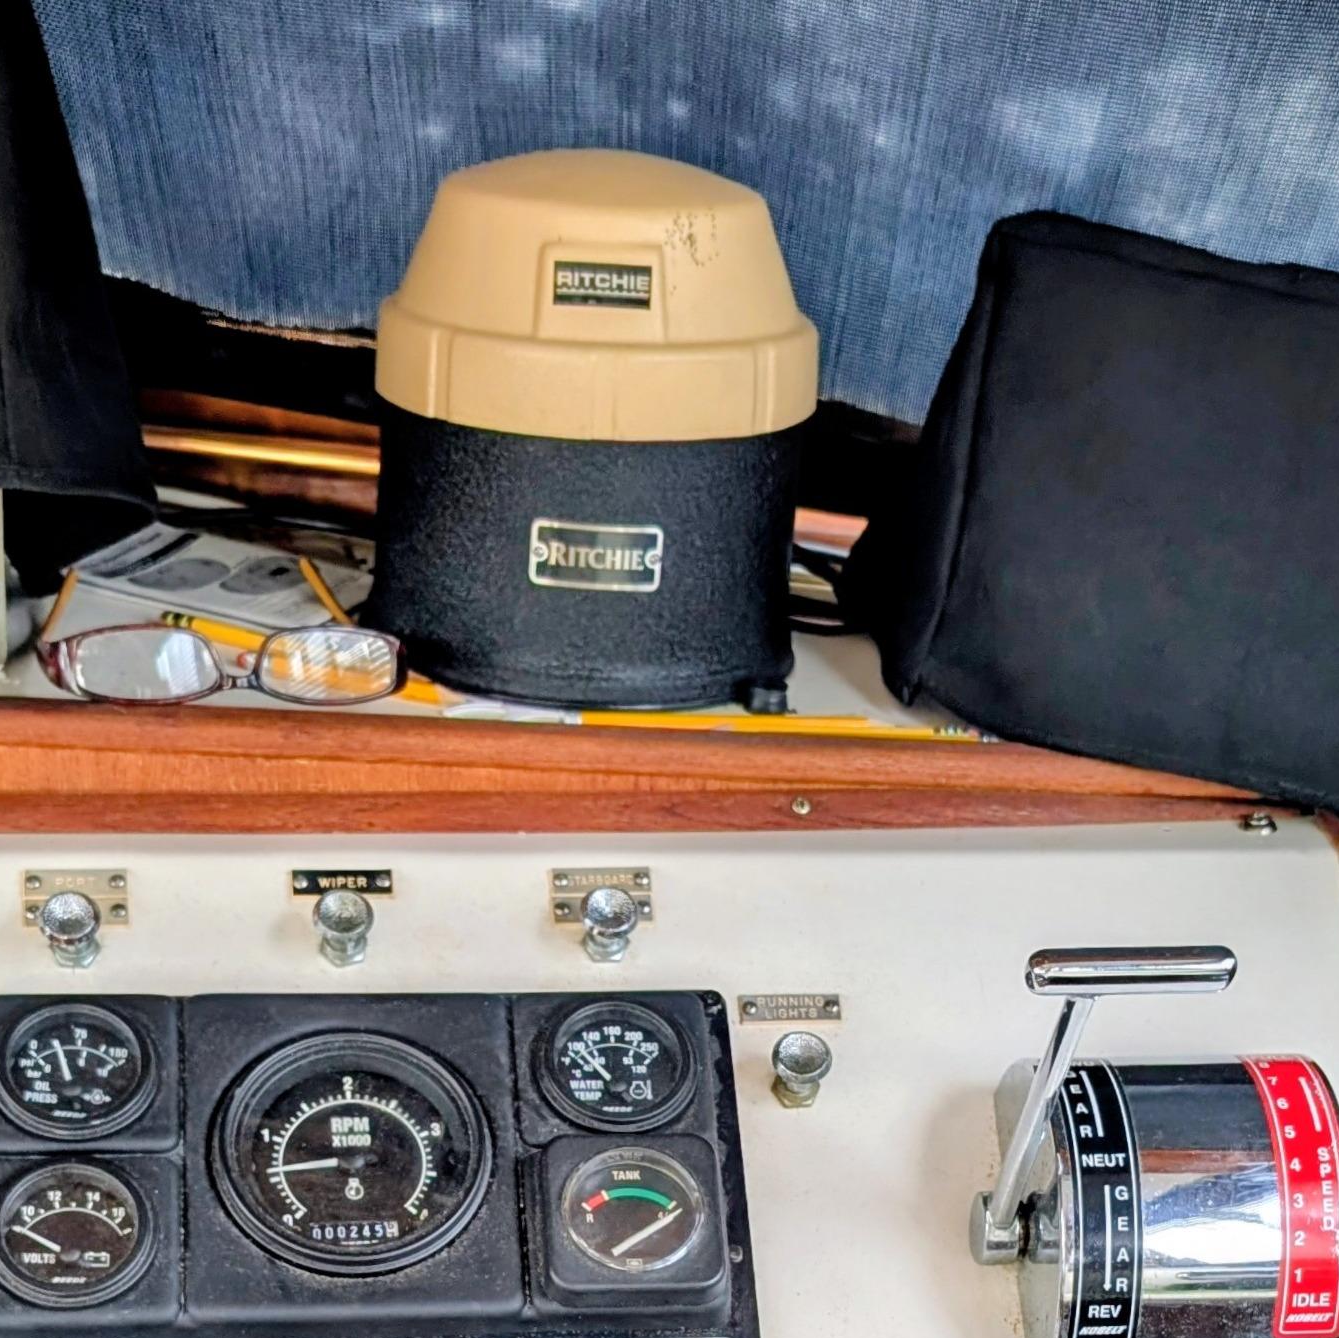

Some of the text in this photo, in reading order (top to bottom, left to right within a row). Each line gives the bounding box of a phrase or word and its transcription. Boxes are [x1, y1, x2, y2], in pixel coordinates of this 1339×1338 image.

[556, 270, 650, 292] RITCHIE
[547, 541, 644, 572] RITCHIE
[55, 876, 96, 888] PORT
[317, 875, 368, 889] WIPER
[757, 996, 824, 1008] RUNNING
[765, 1007, 818, 1019] LIGHTS
[34, 1081, 52, 1091] OIL
[342, 1076, 353, 1090] 2
[569, 1080, 605, 1090] WATER
[1266, 1075, 1278, 1086] 7
[23, 1091, 59, 1104] PRESS
[573, 1091, 602, 1101] TEMP
[1276, 1097, 1289, 1110] 6
[330, 1117, 370, 1133] RPM
[430, 1122, 441, 1136] 3
[1284, 1124, 1296, 1139] 5
[261, 1128, 271, 1142] 1
[331, 1134, 371, 1147] X1000
[1082, 1153, 1126, 1168] NEUT
[1290, 1157, 1301, 1172] 4
[612, 1170, 641, 1180] TANK
[47, 1190, 62, 1201] 12
[1317, 1147, 1334, 1231] SPEED
[86, 1191, 101, 1202] 14
[1293, 1193, 1304, 1208] 3
[586, 1213, 594, 1223] R
[1115, 1186, 1130, 1292] GEAR
[1294, 1231, 1305, 1246] 2
[22, 1252, 57, 1264] VOLTS
[1294, 1268, 1302, 1283] 1
[1292, 1293, 1331, 1307] IDLE
[1087, 1304, 1122, 1318] REV
